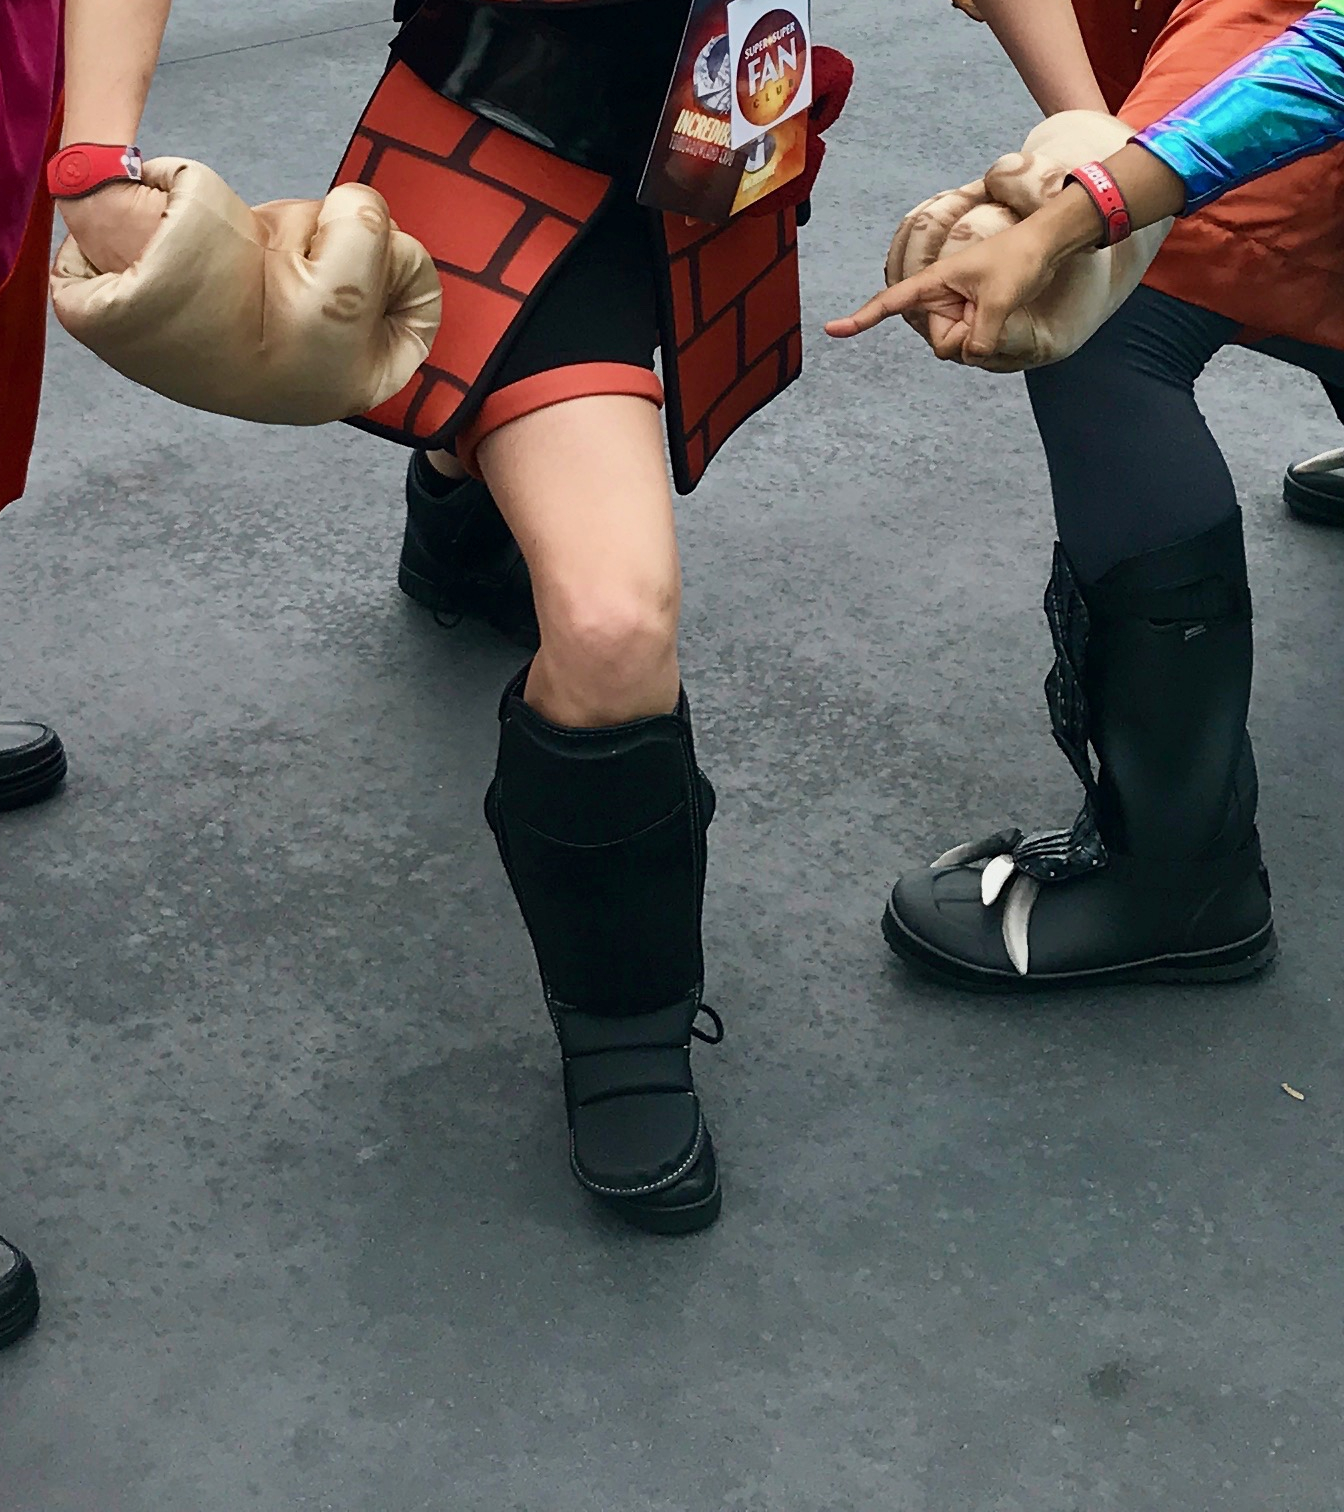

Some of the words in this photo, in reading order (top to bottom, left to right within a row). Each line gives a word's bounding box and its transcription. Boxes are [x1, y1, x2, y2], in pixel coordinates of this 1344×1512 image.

[744, 36, 769, 60] SUPER
[771, 21, 796, 44] SUPER
[747, 37, 797, 97] FAN
